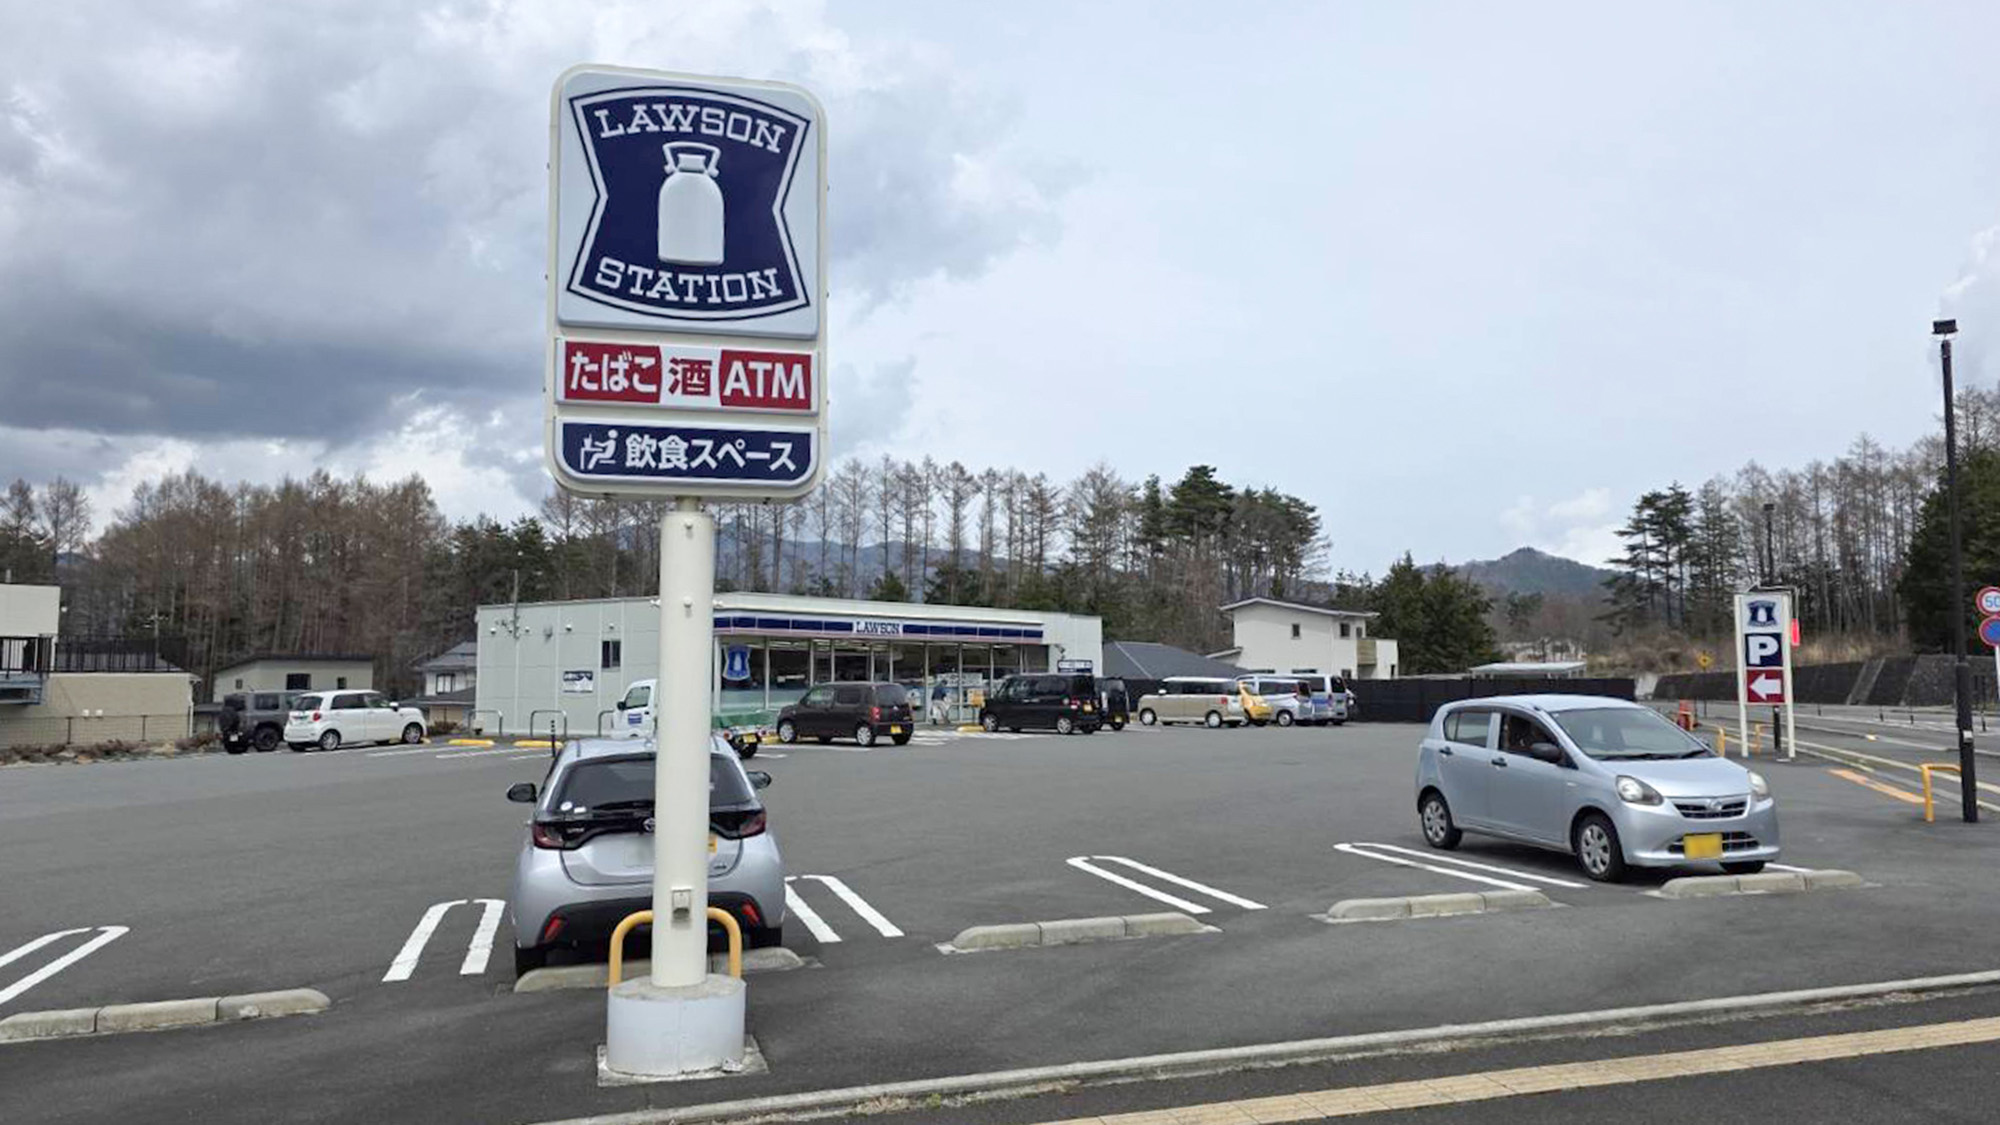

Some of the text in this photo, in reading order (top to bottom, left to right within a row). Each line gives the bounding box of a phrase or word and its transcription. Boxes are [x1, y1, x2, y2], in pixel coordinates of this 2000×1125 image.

[595, 104, 786, 153] LAWSON
[595, 257, 782, 303] STATION
[570, 351, 806, 399] たばこ 酒 ATM
[625, 433, 796, 472] 飲食スペース
[856, 621, 900, 635] LAWSON
[1747, 635, 1779, 665] P
